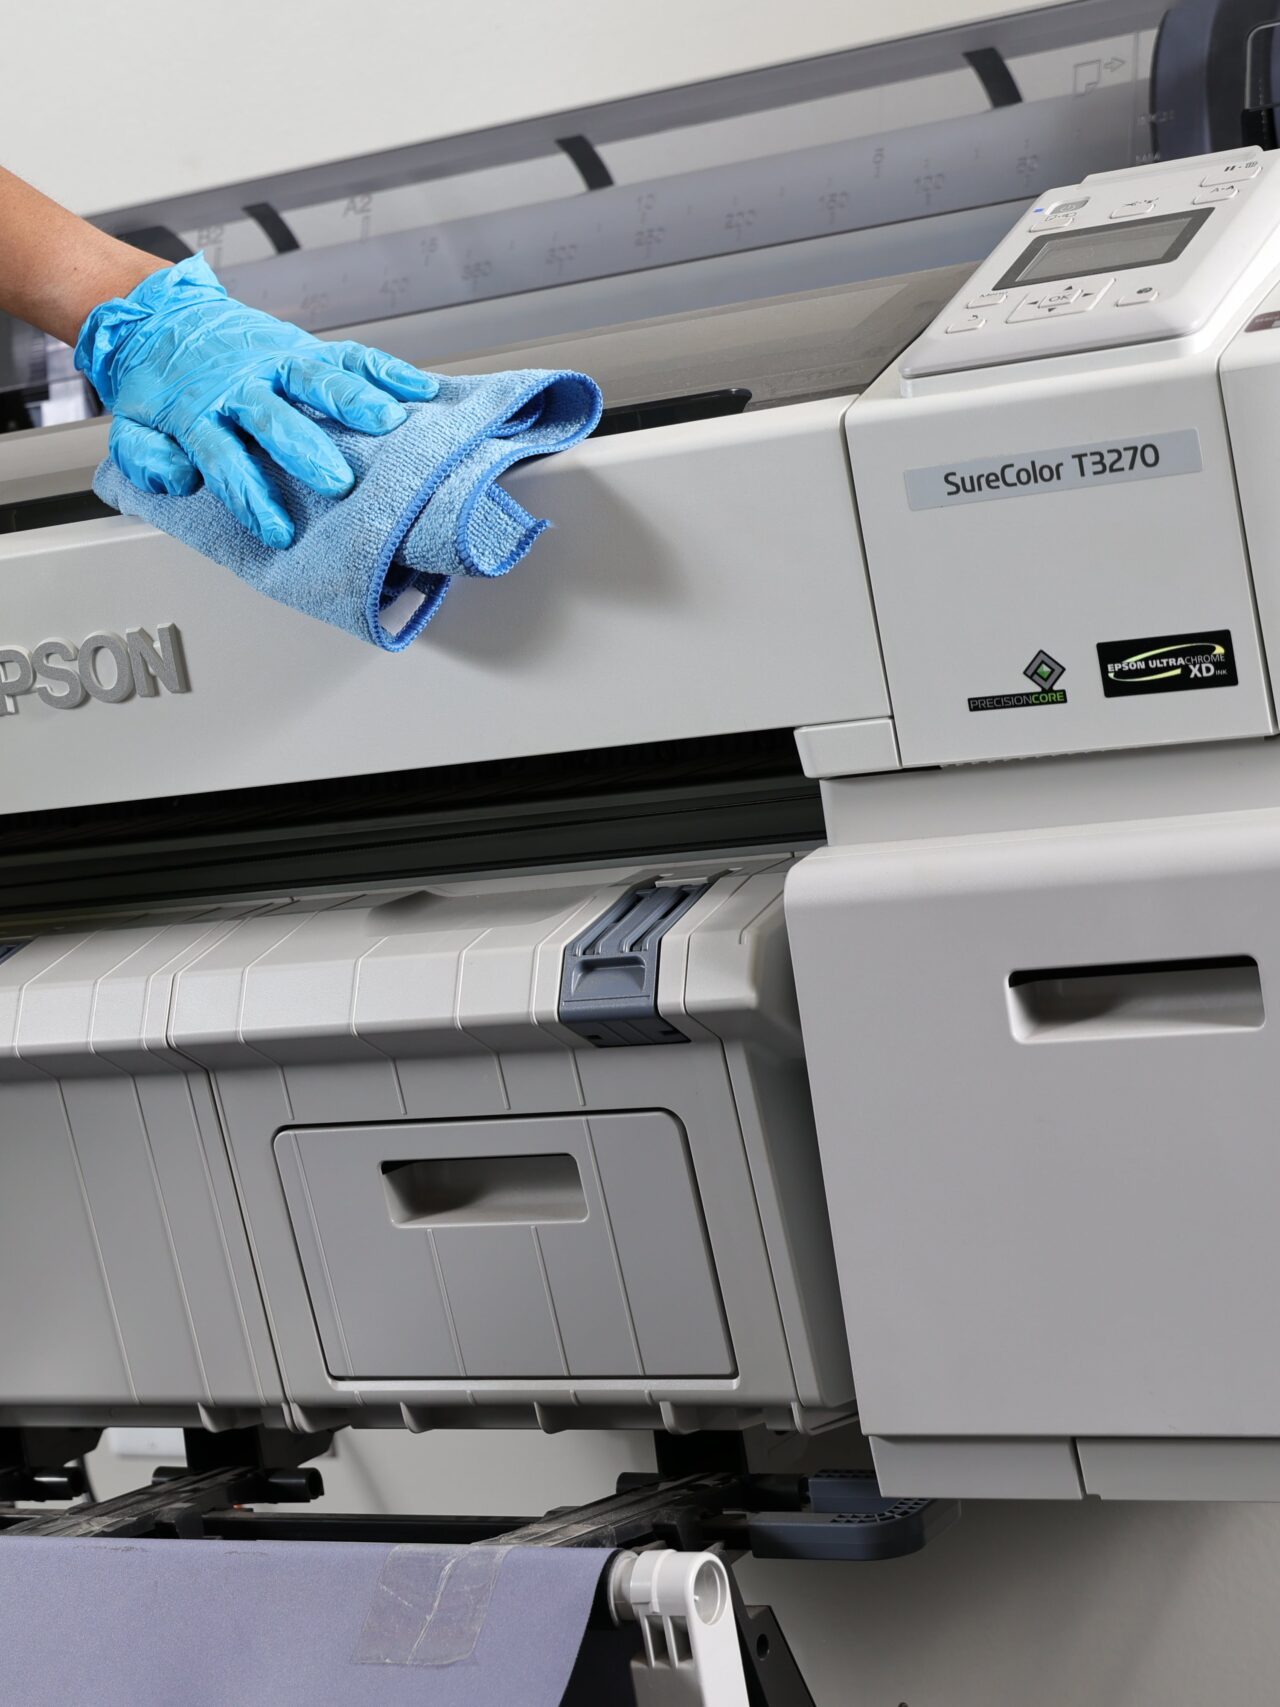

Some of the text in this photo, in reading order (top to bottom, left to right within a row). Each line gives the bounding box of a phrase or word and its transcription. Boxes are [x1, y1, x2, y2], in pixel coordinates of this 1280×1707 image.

[343, 194, 373, 218] A2
[1048, 294, 1070, 303] OK
[943, 443, 1160, 496] SureColor T3270
[1107, 654, 1226, 673] EPSON ULTRACHROME
[1188, 662, 1215, 679] XD
[969, 691, 1066, 711] PRECISIONCORE
